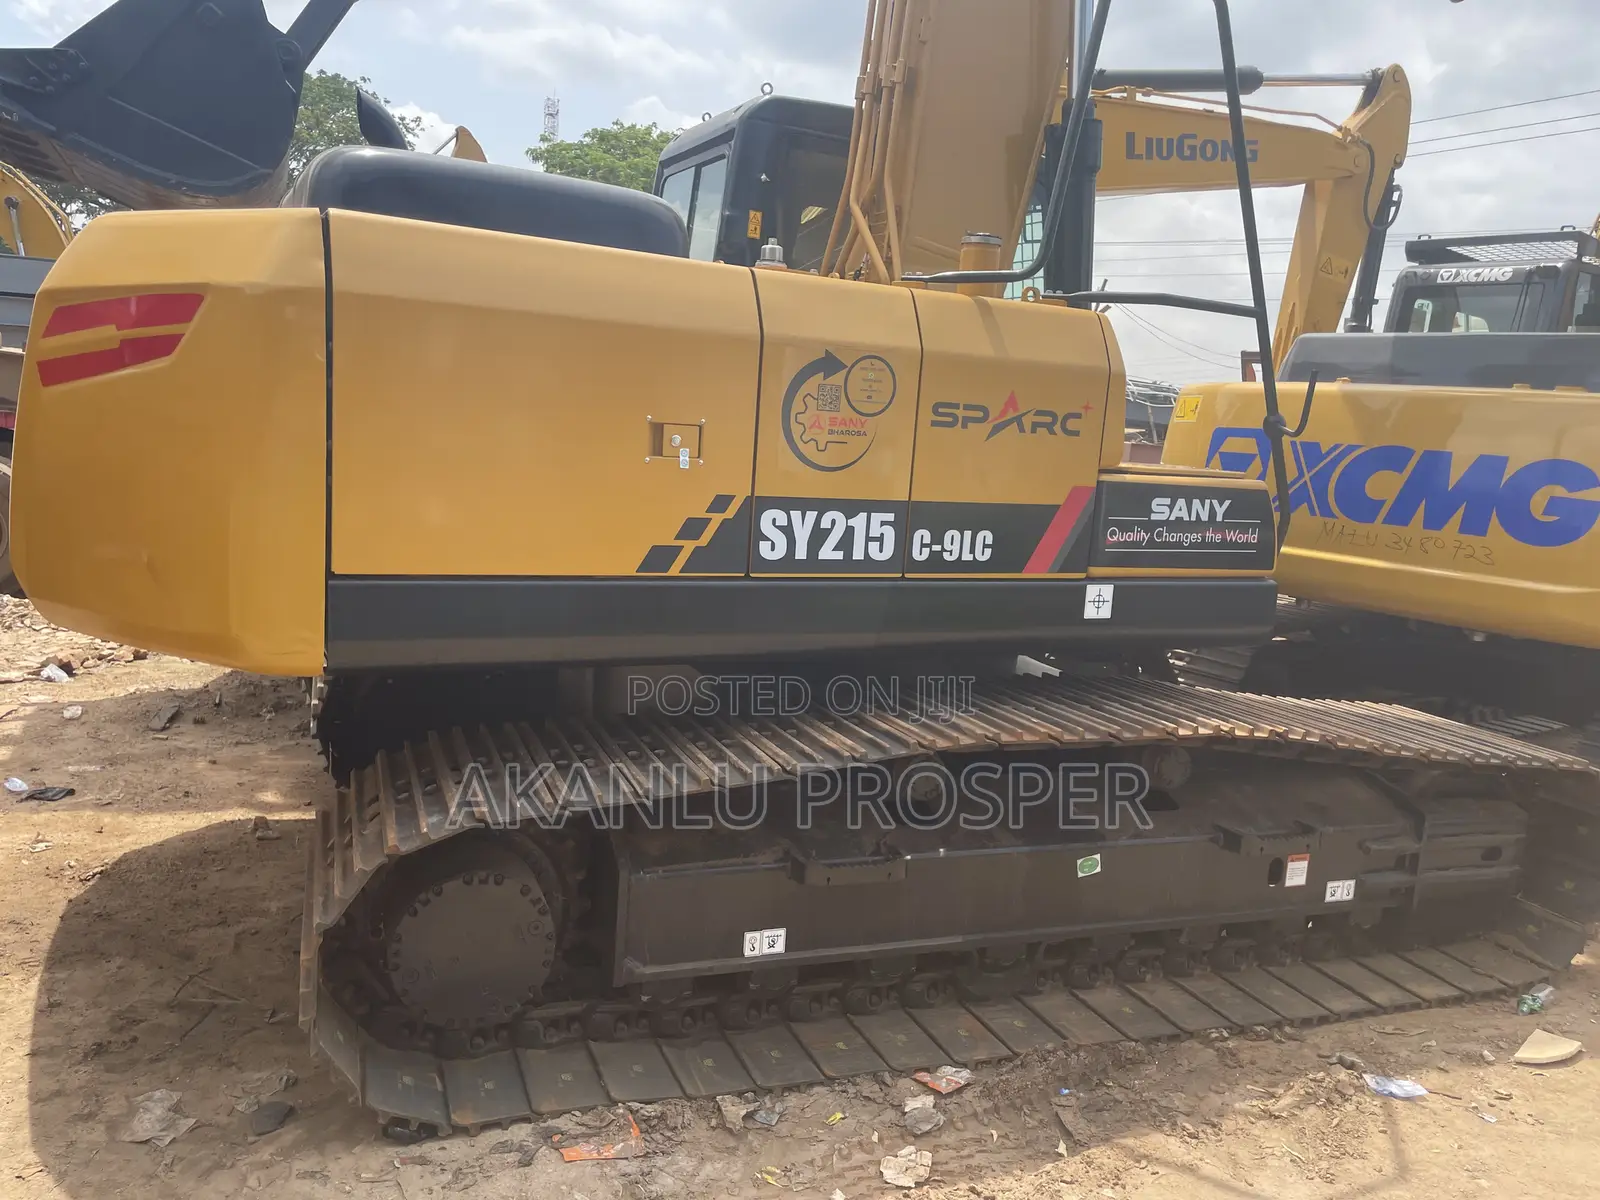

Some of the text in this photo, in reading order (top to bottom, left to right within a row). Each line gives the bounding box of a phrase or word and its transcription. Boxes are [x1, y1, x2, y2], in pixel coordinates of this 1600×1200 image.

[1453, 267, 1513, 283] XCMG
[828, 417, 868, 429] SANY
[930, 391, 1082, 442] SPARC
[828, 428, 867, 437] BHAROSA
[1272, 440, 1600, 547] XCMG
[1150, 497, 1232, 522] SANY
[758, 508, 993, 562] SY215 C-9LC
[1107, 527, 1259, 546] Quality Changes the World
